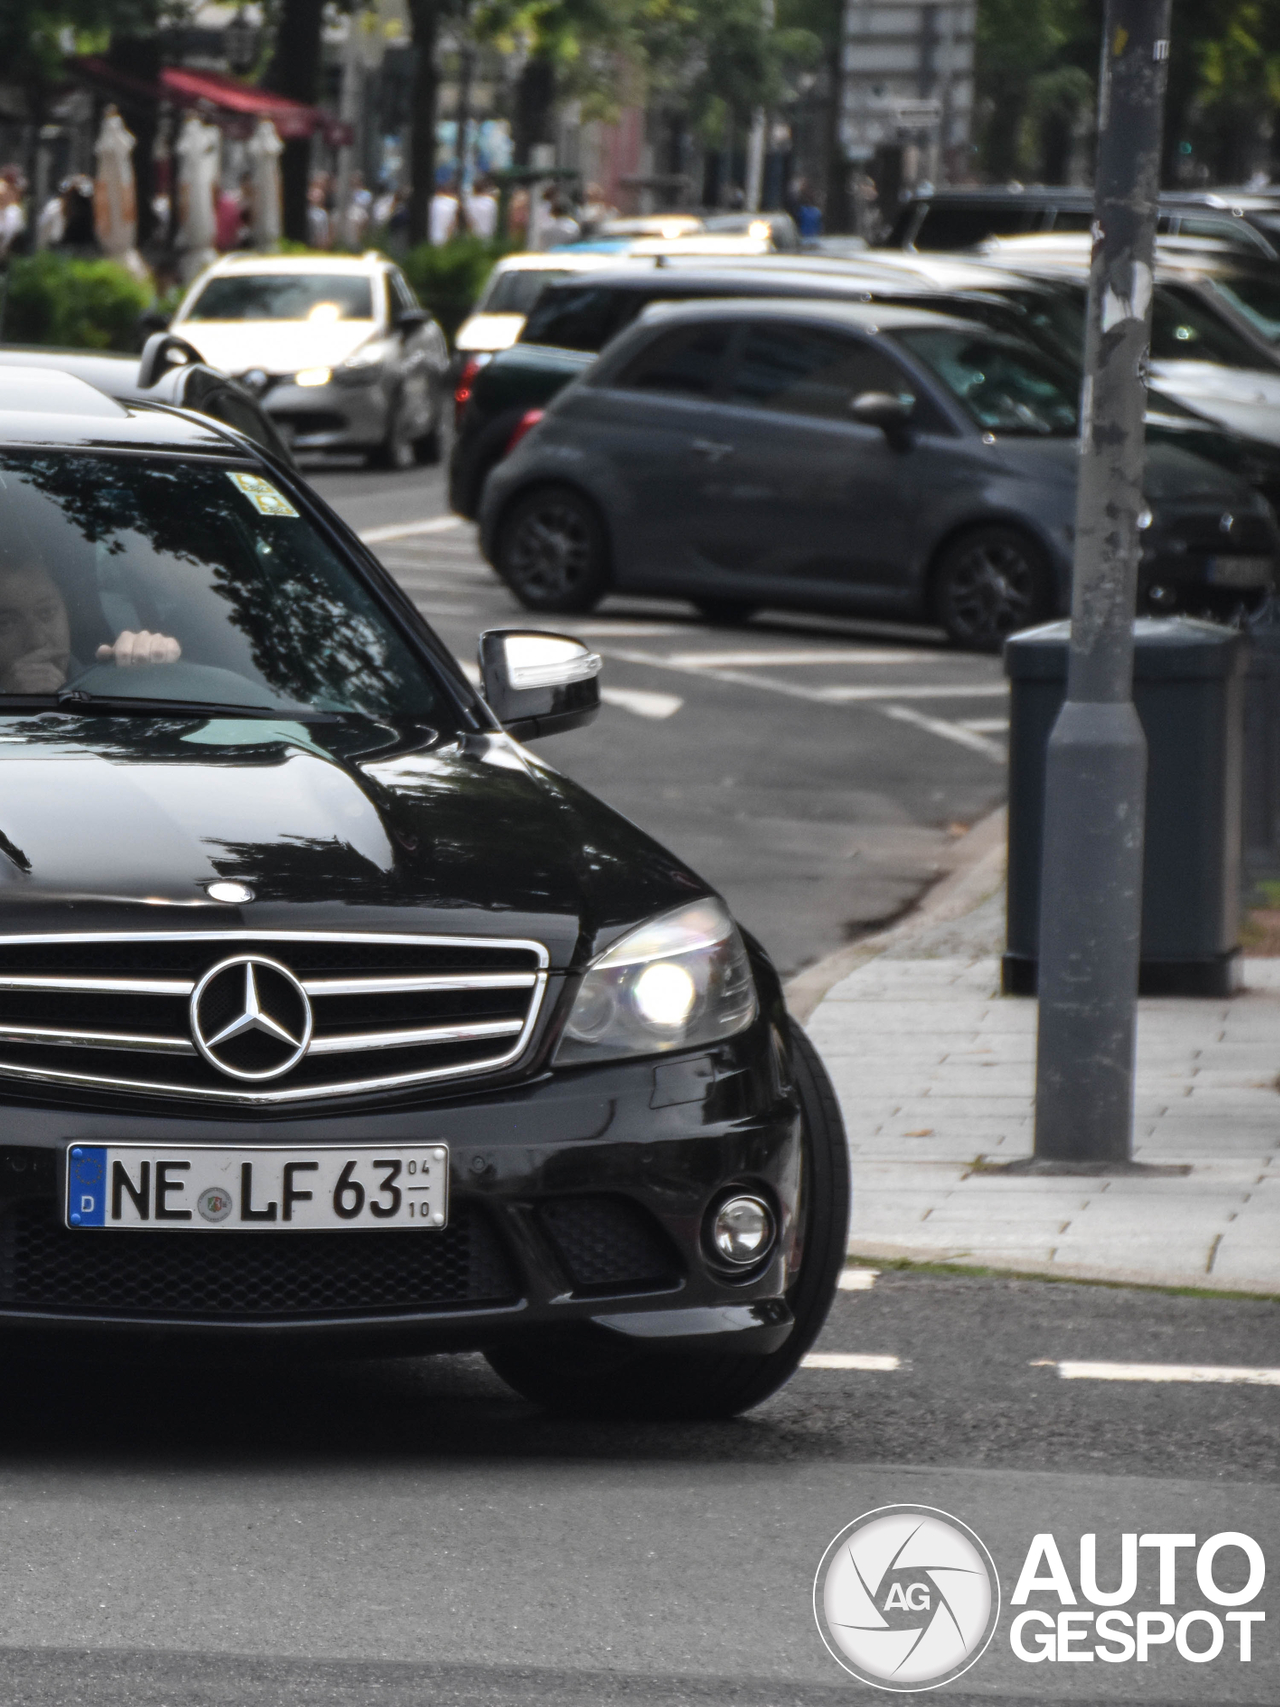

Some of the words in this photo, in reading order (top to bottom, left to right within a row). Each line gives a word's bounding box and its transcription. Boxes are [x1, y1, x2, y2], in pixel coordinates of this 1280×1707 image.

[408, 1159, 430, 1175] 04
[111, 1160, 192, 1220] NE
[241, 1161, 319, 1221] LF
[333, 1159, 402, 1219] 63
[81, 1195, 95, 1212] D
[408, 1201, 430, 1217] 10
